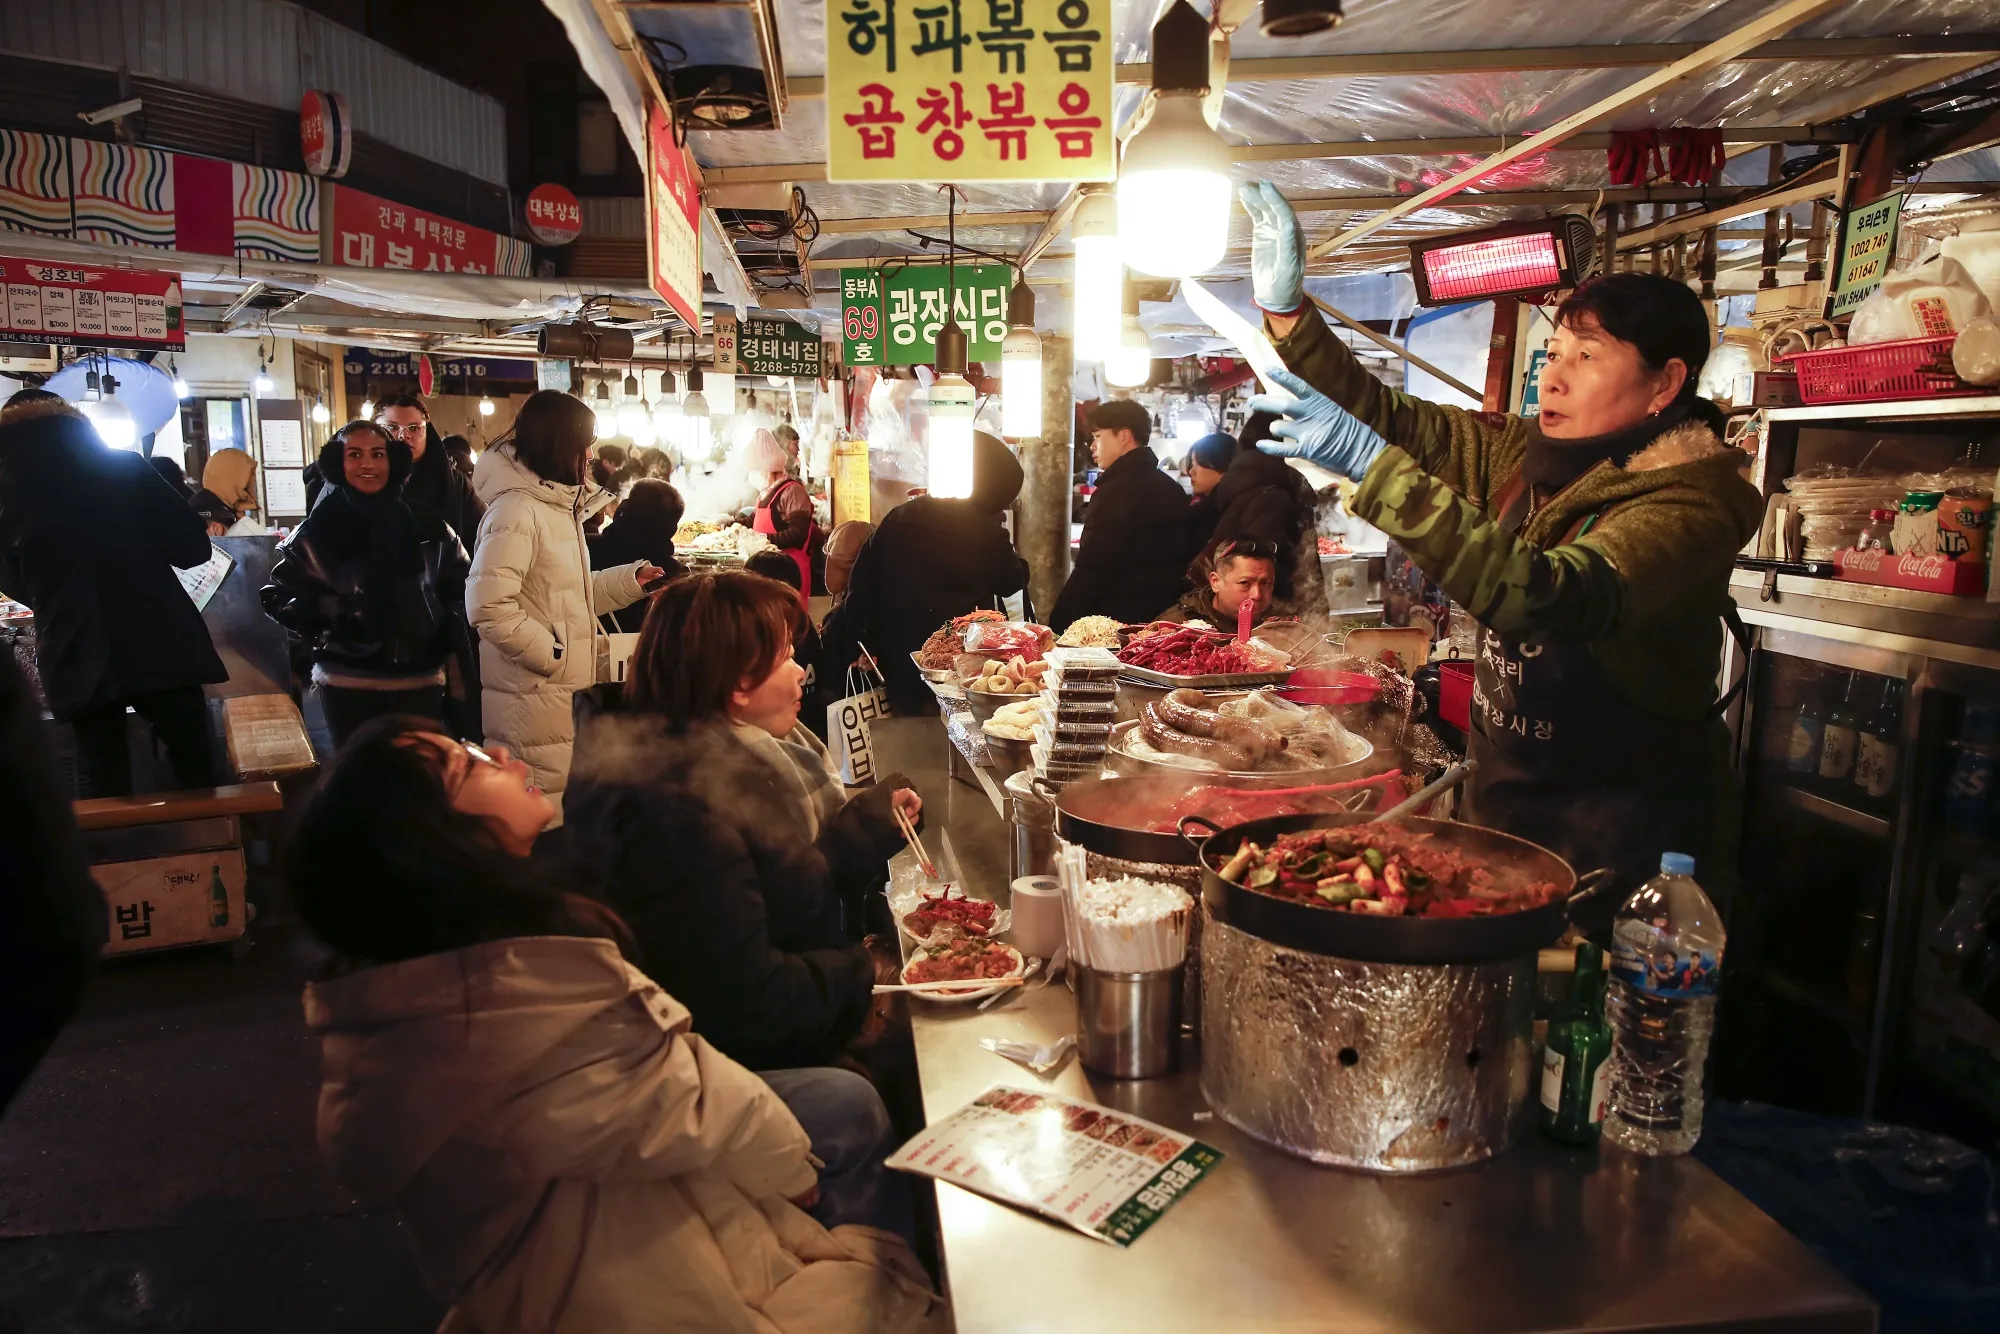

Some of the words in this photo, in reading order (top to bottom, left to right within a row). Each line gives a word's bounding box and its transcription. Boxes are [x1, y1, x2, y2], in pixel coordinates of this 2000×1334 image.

[841, 0, 1101, 73] 허파볶음
[844, 82, 1102, 161] 곱창볶음
[378, 206, 406, 233] 건과
[530, 199, 580, 224] 대복상회
[1857, 206, 1891, 232] 우리은행
[1850, 242, 1870, 259] 1002
[1872, 232, 1889, 251] 749
[39, 267, 86, 283] 성호네
[1848, 260, 1879, 282] 611647
[9, 288, 39, 298] 잔치국수
[844, 278, 878, 299] 동부A
[106, 295, 134, 305] 머릿고기
[16, 318, 37, 326] 4,000
[844, 305, 879, 341] 69
[889, 285, 1009, 345] 광장식당
[0, 332, 18, 342] 걸리,
[111, 325, 133, 333] 10,000
[144, 327, 162, 335] 7,000
[718, 337, 734, 349] 66
[741, 338, 819, 362] 경태네집
[854, 342, 875, 362] 호
[753, 360, 819, 375] 2268-5723
[1937, 528, 1970, 552] NTA
